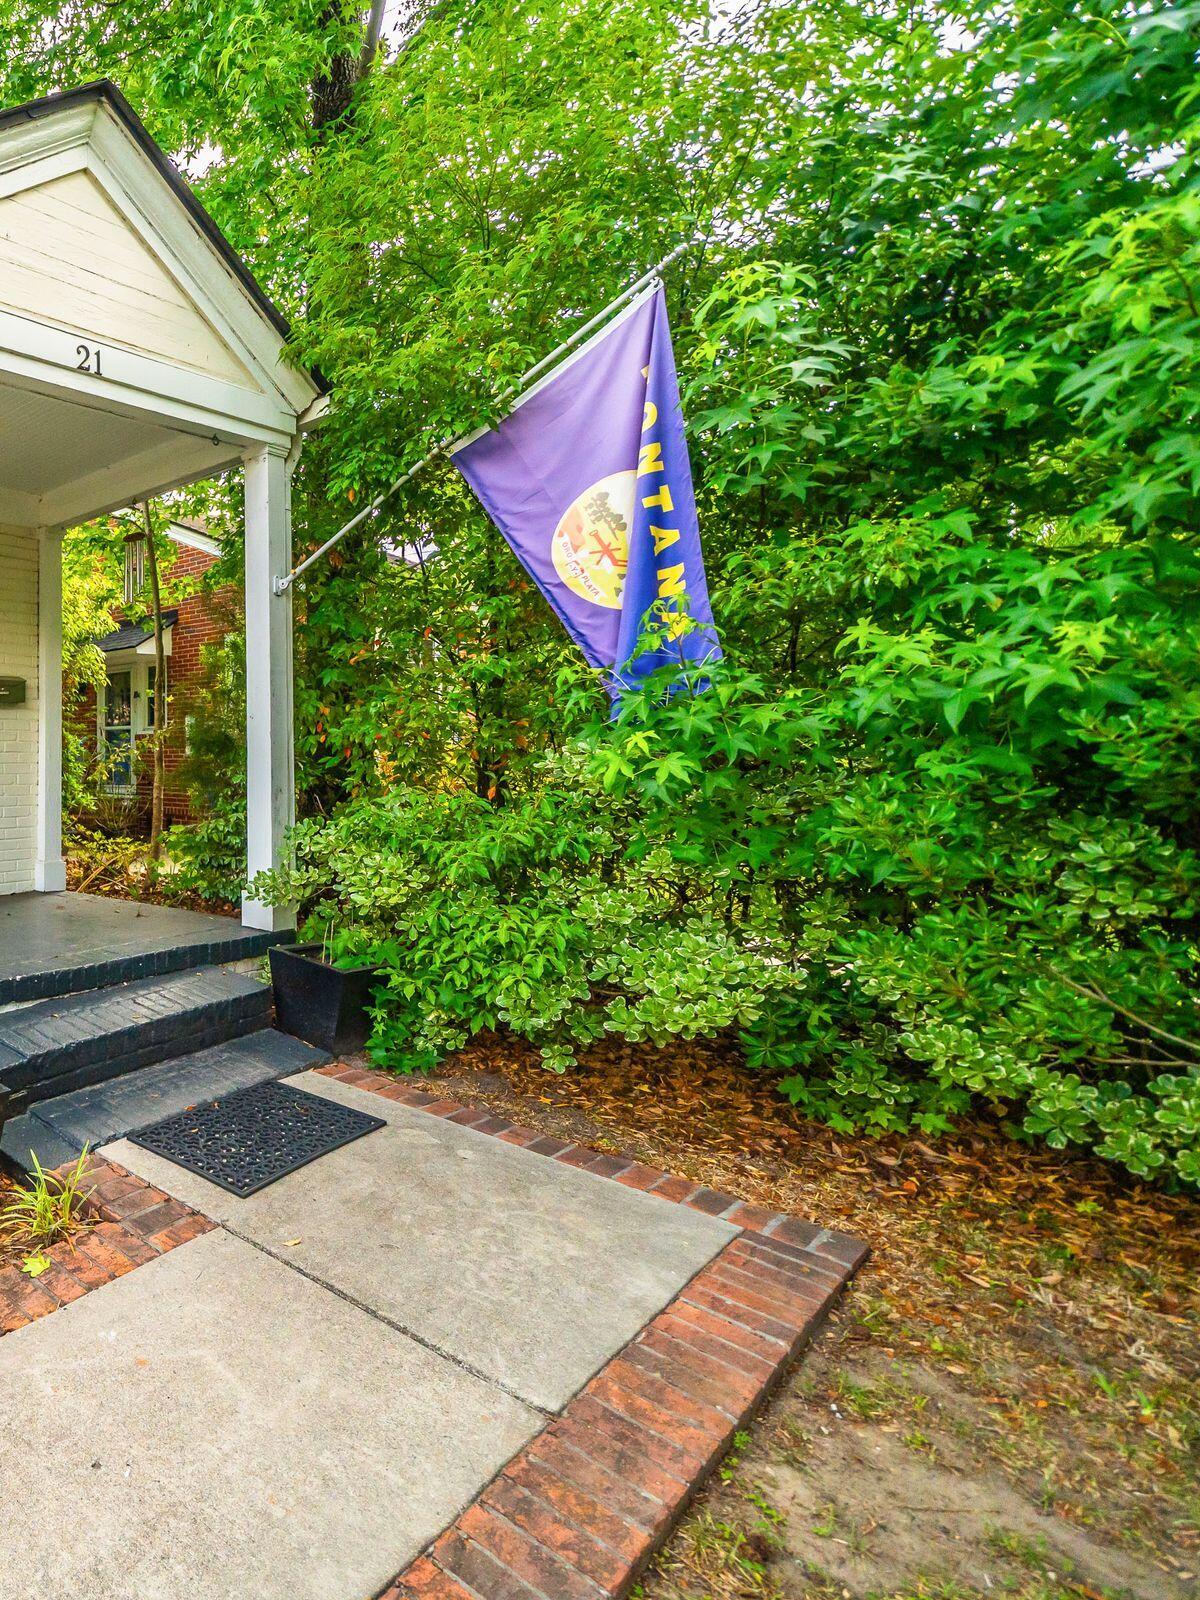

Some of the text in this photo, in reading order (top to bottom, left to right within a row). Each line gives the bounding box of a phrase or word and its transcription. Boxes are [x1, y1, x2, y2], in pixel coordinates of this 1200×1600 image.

[76, 344, 102, 376] 21
[637, 365, 688, 642] ONTANA
[582, 575, 600, 597] PLATA
